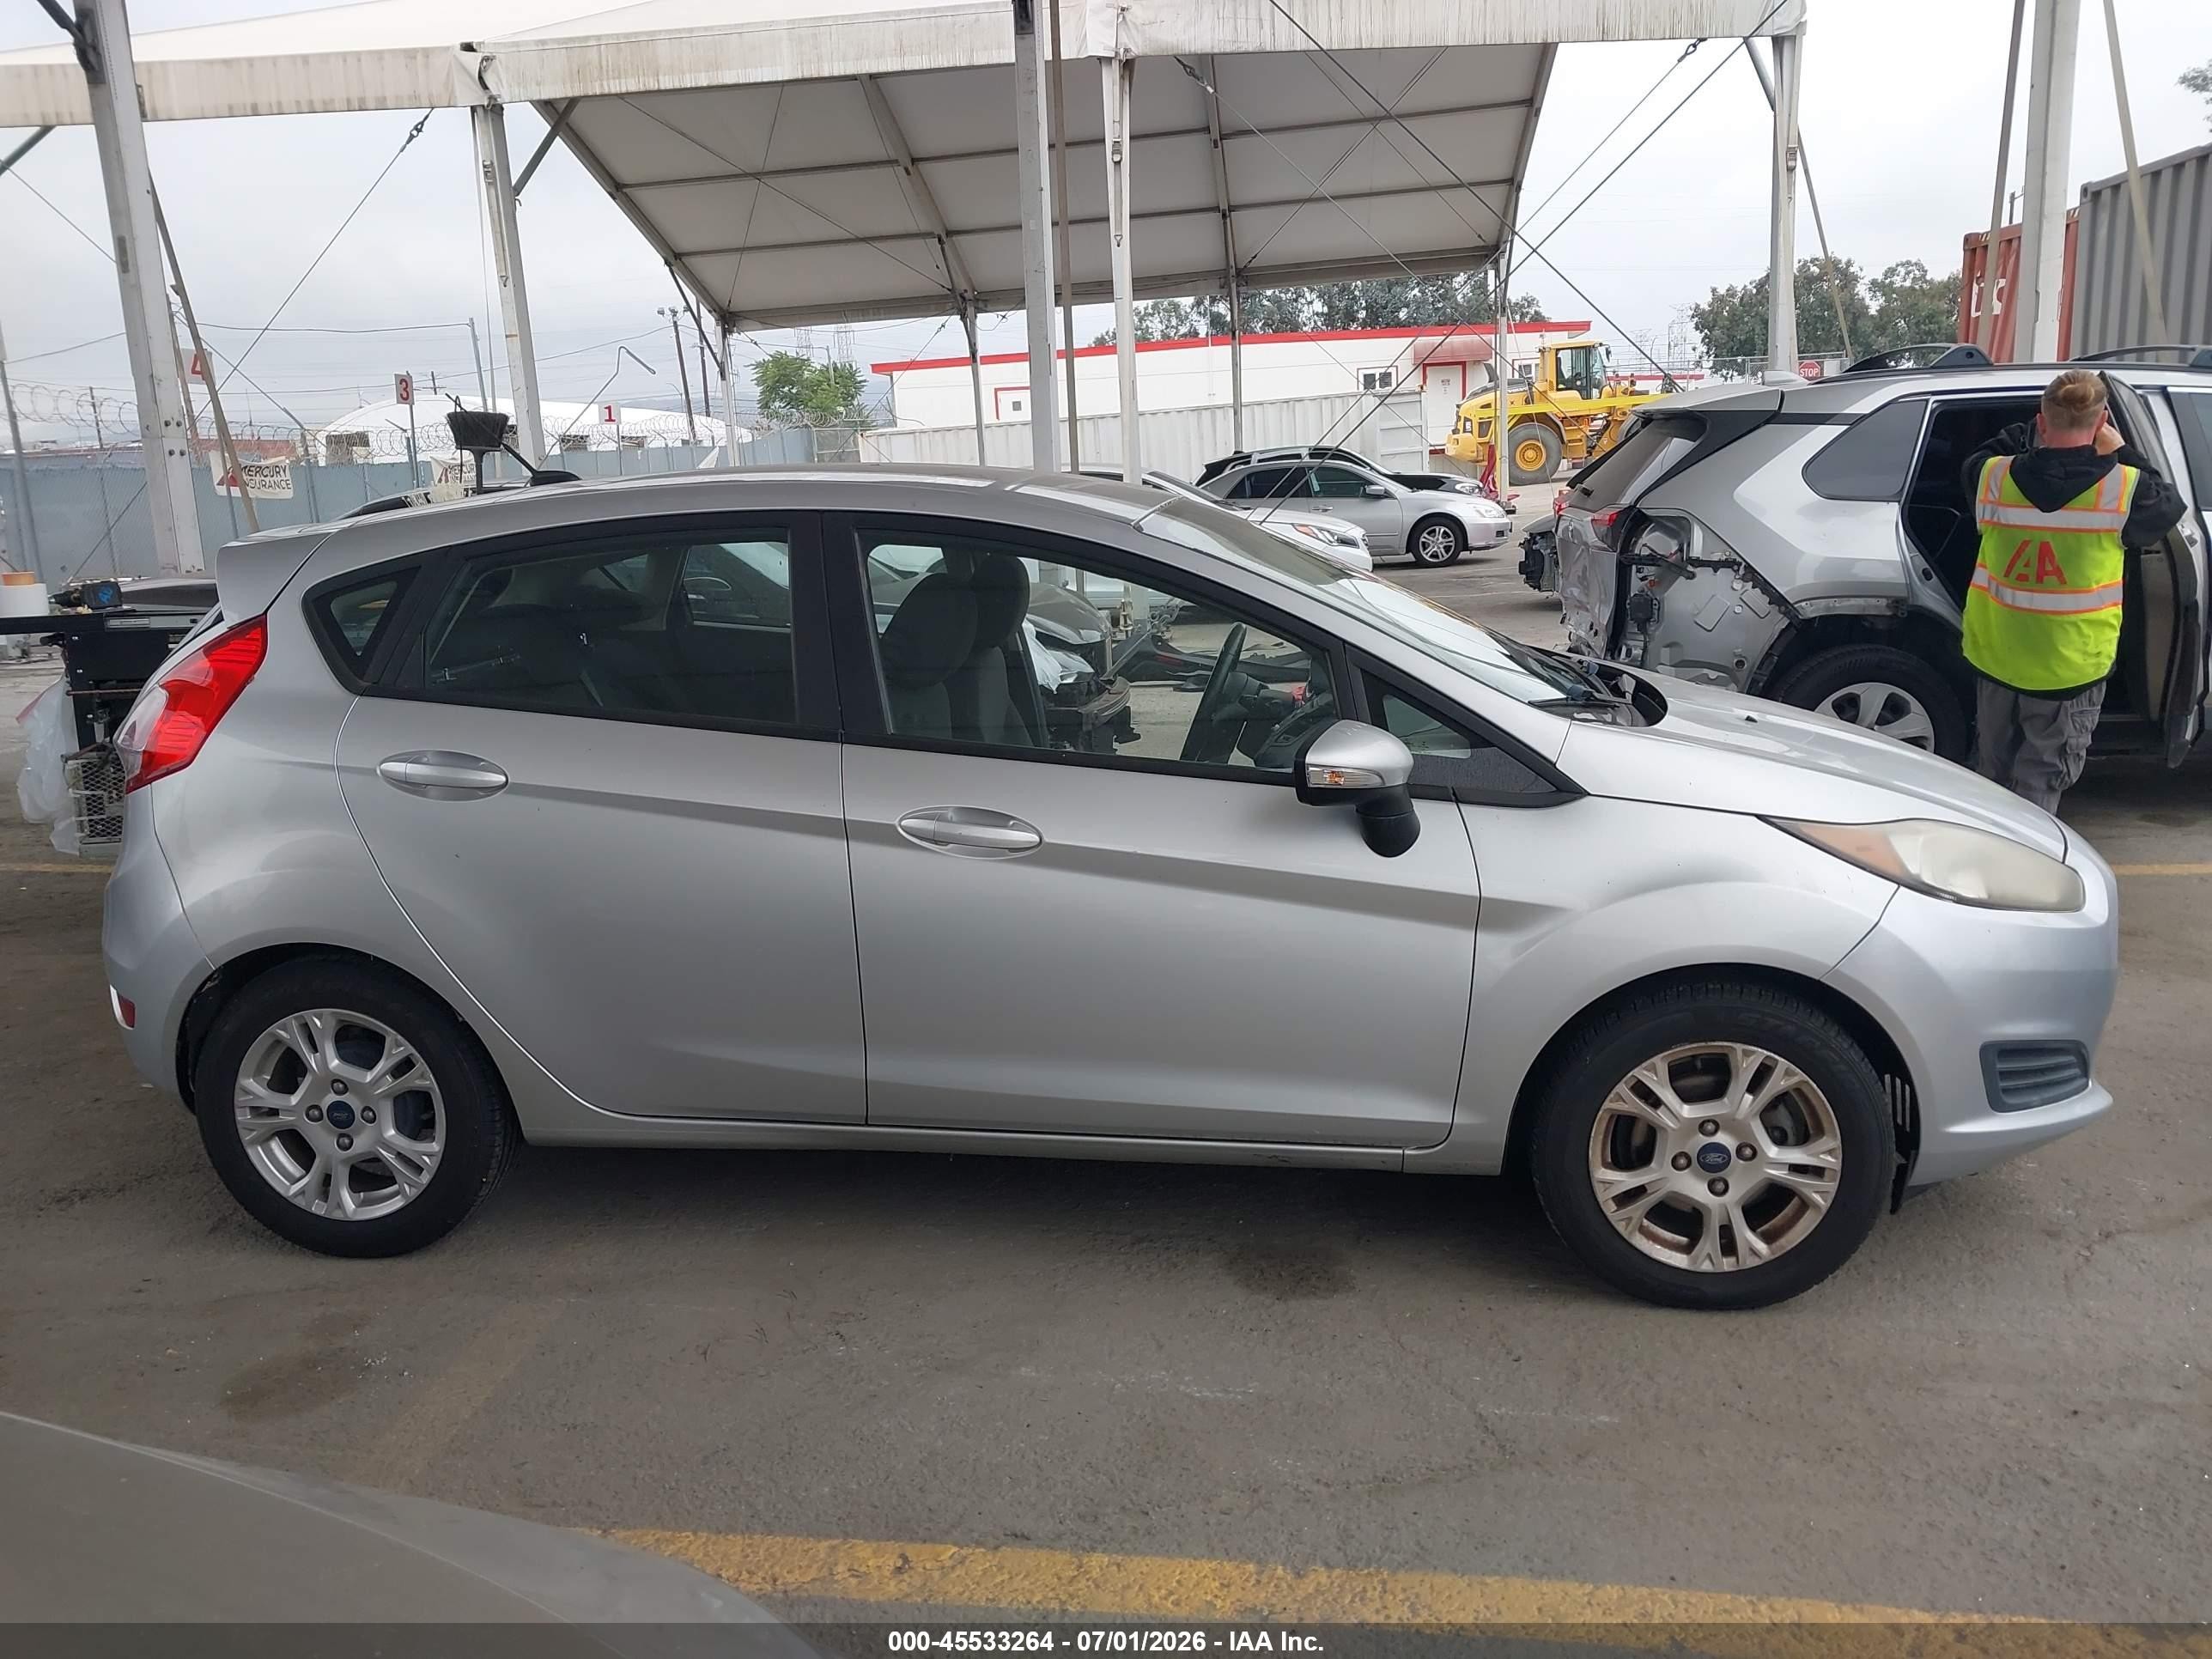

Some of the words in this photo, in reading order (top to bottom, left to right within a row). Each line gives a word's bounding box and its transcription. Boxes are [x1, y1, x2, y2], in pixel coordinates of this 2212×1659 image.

[1800, 368, 1819, 377] STOP
[398, 378, 410, 401] 3
[604, 404, 617, 422] 1
[245, 477, 292, 490] NSURANCE
